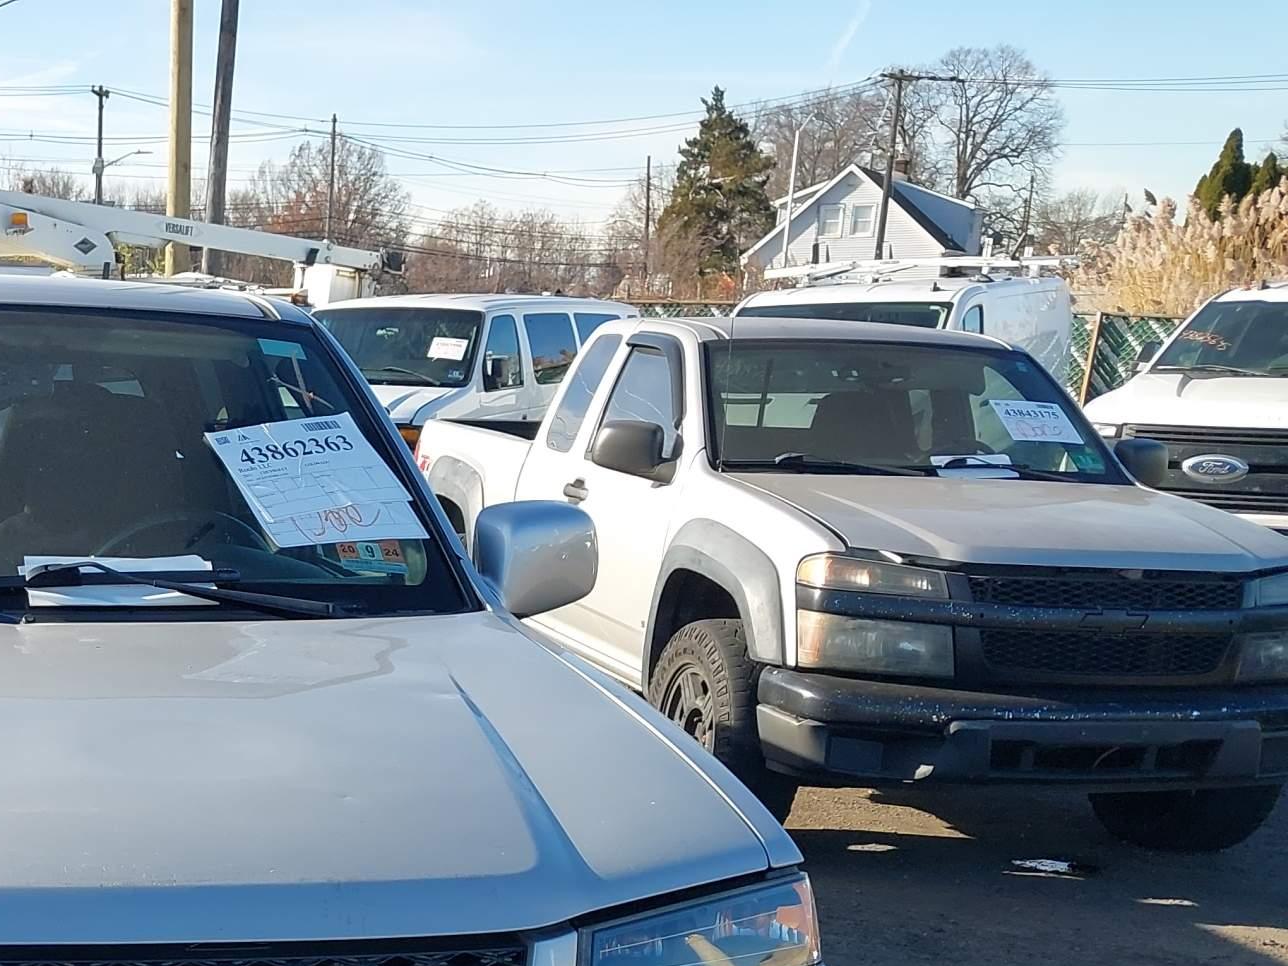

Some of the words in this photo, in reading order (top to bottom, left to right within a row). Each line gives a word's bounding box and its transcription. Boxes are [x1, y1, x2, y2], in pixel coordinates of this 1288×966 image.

[165, 221, 193, 236] VERSALIFT
[1004, 408, 1059, 420] 43843175
[241, 434, 353, 464] 43862363
[1198, 461, 1230, 473] Ford
[340, 544, 356, 554] 20
[365, 544, 376, 559] 9
[384, 548, 400, 557] 24
